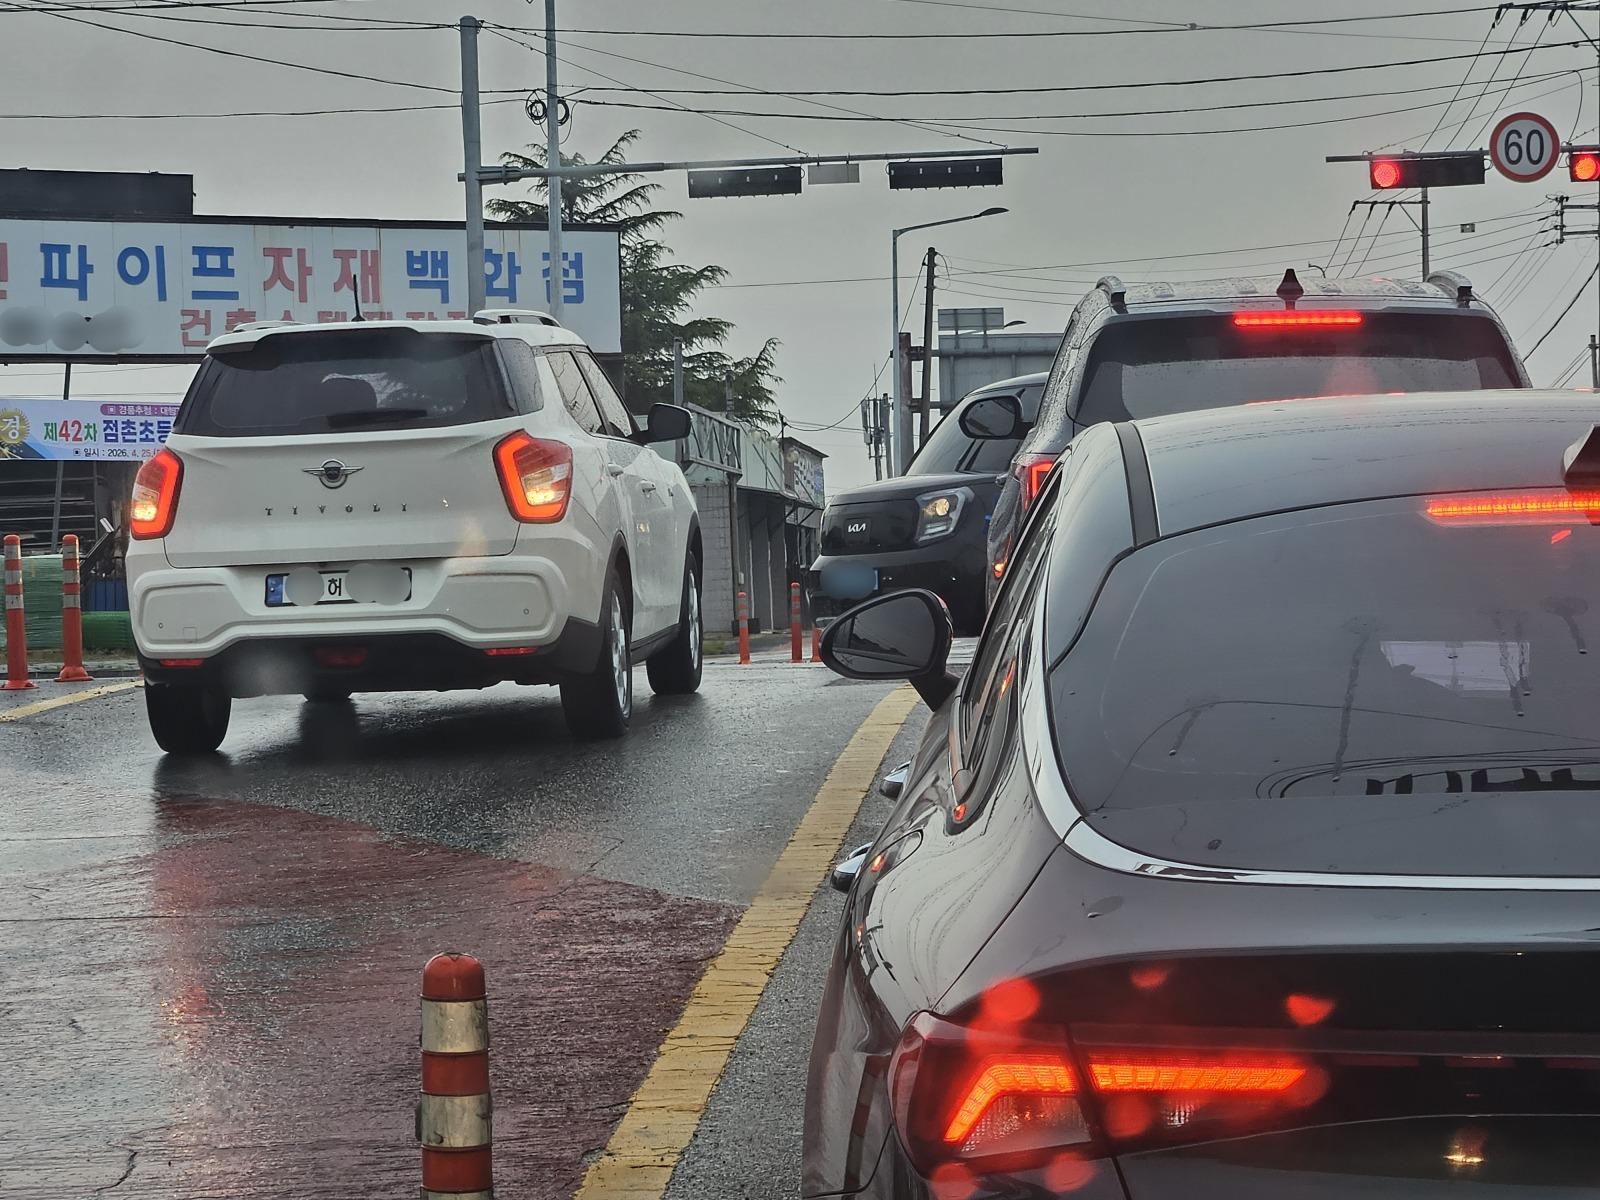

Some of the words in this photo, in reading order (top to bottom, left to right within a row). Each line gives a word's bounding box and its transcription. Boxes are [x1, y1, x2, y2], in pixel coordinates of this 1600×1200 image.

[1504, 129, 1545, 165] 60
[0, 415, 20, 440] 경
[43, 420, 98, 443] 제42차
[83, 448, 100, 457] 일시
[264, 503, 408, 516] TIVOLI
[847, 522, 867, 533] KIA
[327, 578, 342, 597] 허
